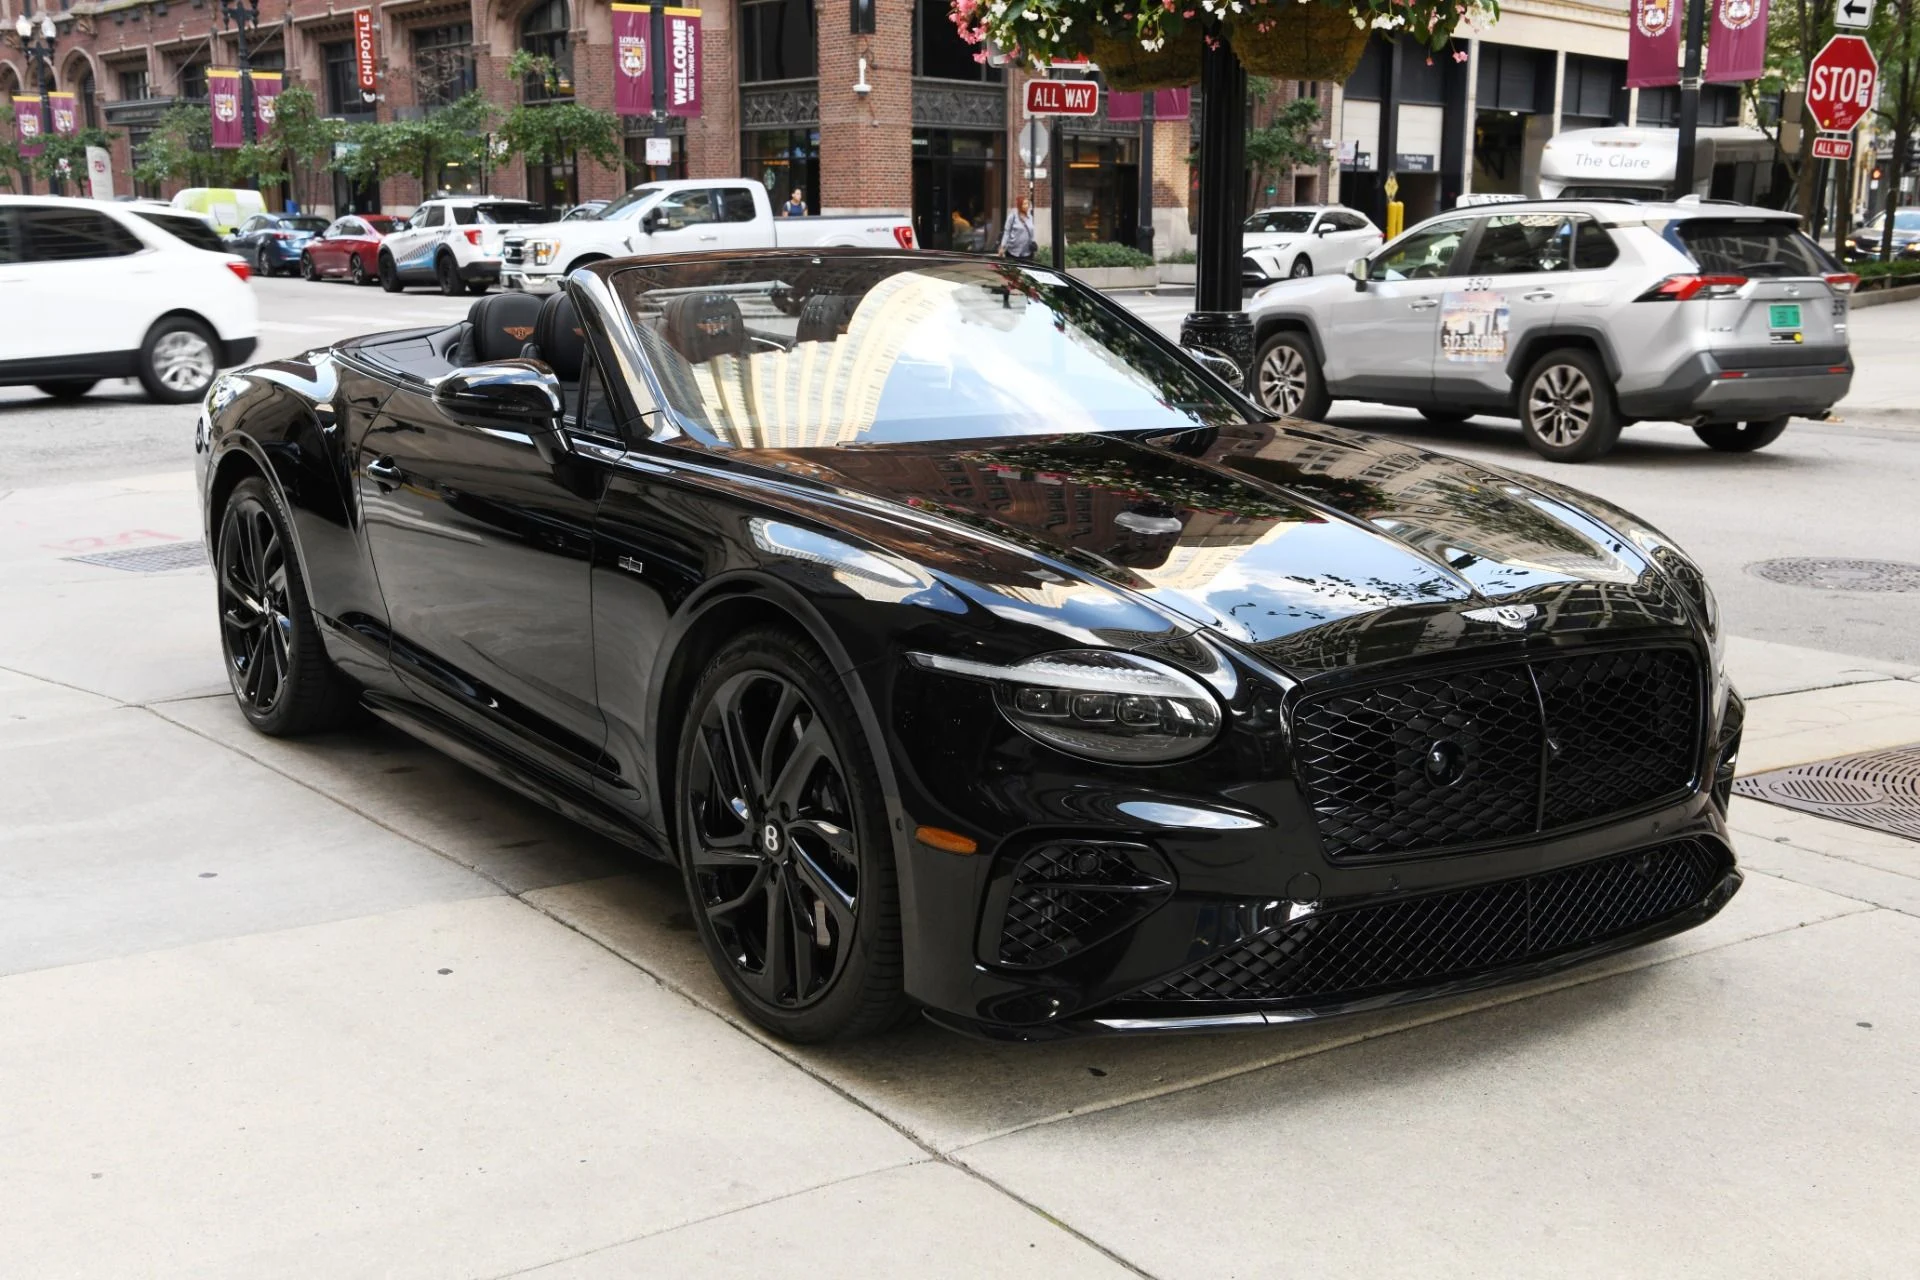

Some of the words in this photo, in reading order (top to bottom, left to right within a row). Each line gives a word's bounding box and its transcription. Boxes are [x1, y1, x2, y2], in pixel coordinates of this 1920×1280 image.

[358, 14, 374, 86] CHIPOTLE
[619, 36, 645, 44] LOYOLA
[672, 19, 687, 105] WELCOME
[1812, 65, 1873, 104] STOP
[1034, 88, 1060, 107] ALL
[1065, 89, 1091, 108] WAY
[1816, 142, 1832, 154] ALL
[1834, 143, 1849, 155] WAY
[1575, 154, 1602, 167] The
[1608, 155, 1650, 169] Clare
